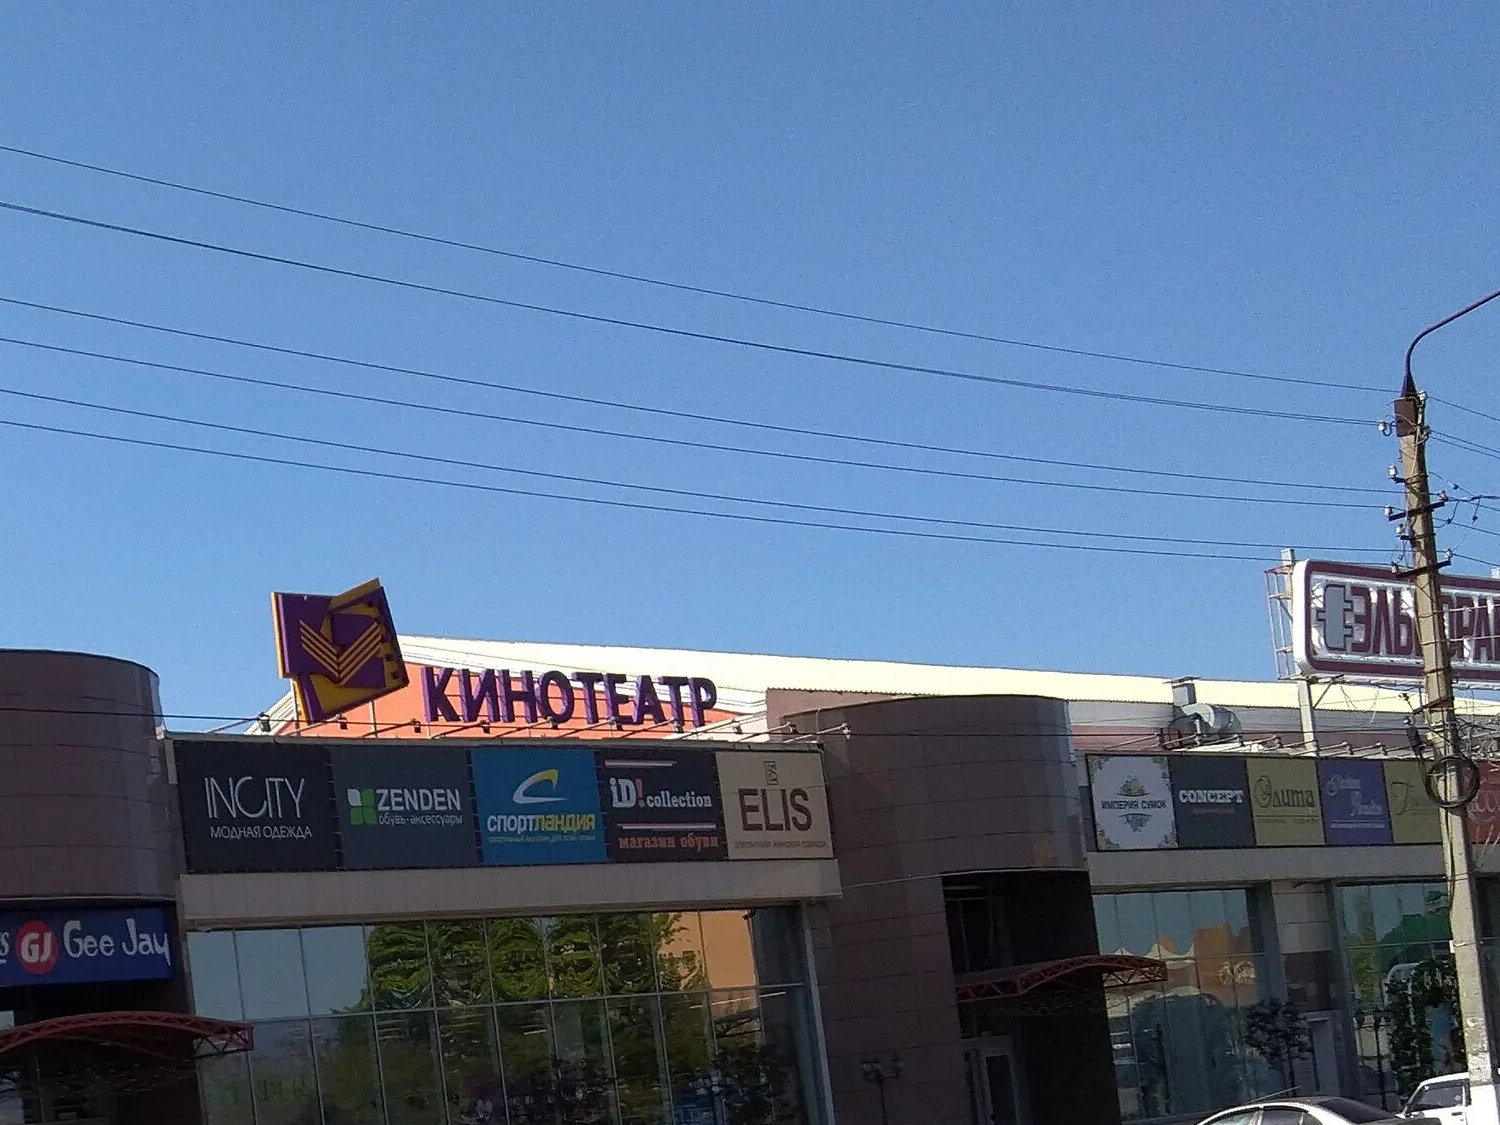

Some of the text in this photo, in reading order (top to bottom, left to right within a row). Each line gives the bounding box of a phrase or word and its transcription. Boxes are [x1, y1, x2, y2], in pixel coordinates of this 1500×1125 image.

[419, 665, 718, 727] КИНОТЕАТР
[204, 776, 305, 819] INCITY
[376, 788, 462, 811] ZENDEN
[646, 790, 713, 808] collection
[1178, 789, 1244, 804] CONCEPT
[737, 787, 812, 832] ELIS
[210, 824, 313, 840] МОДНАЯ ОДЕЖДА
[618, 835, 677, 849] магазин
[679, 832, 719, 851] обуви
[62, 917, 171, 967] Gee Jay
